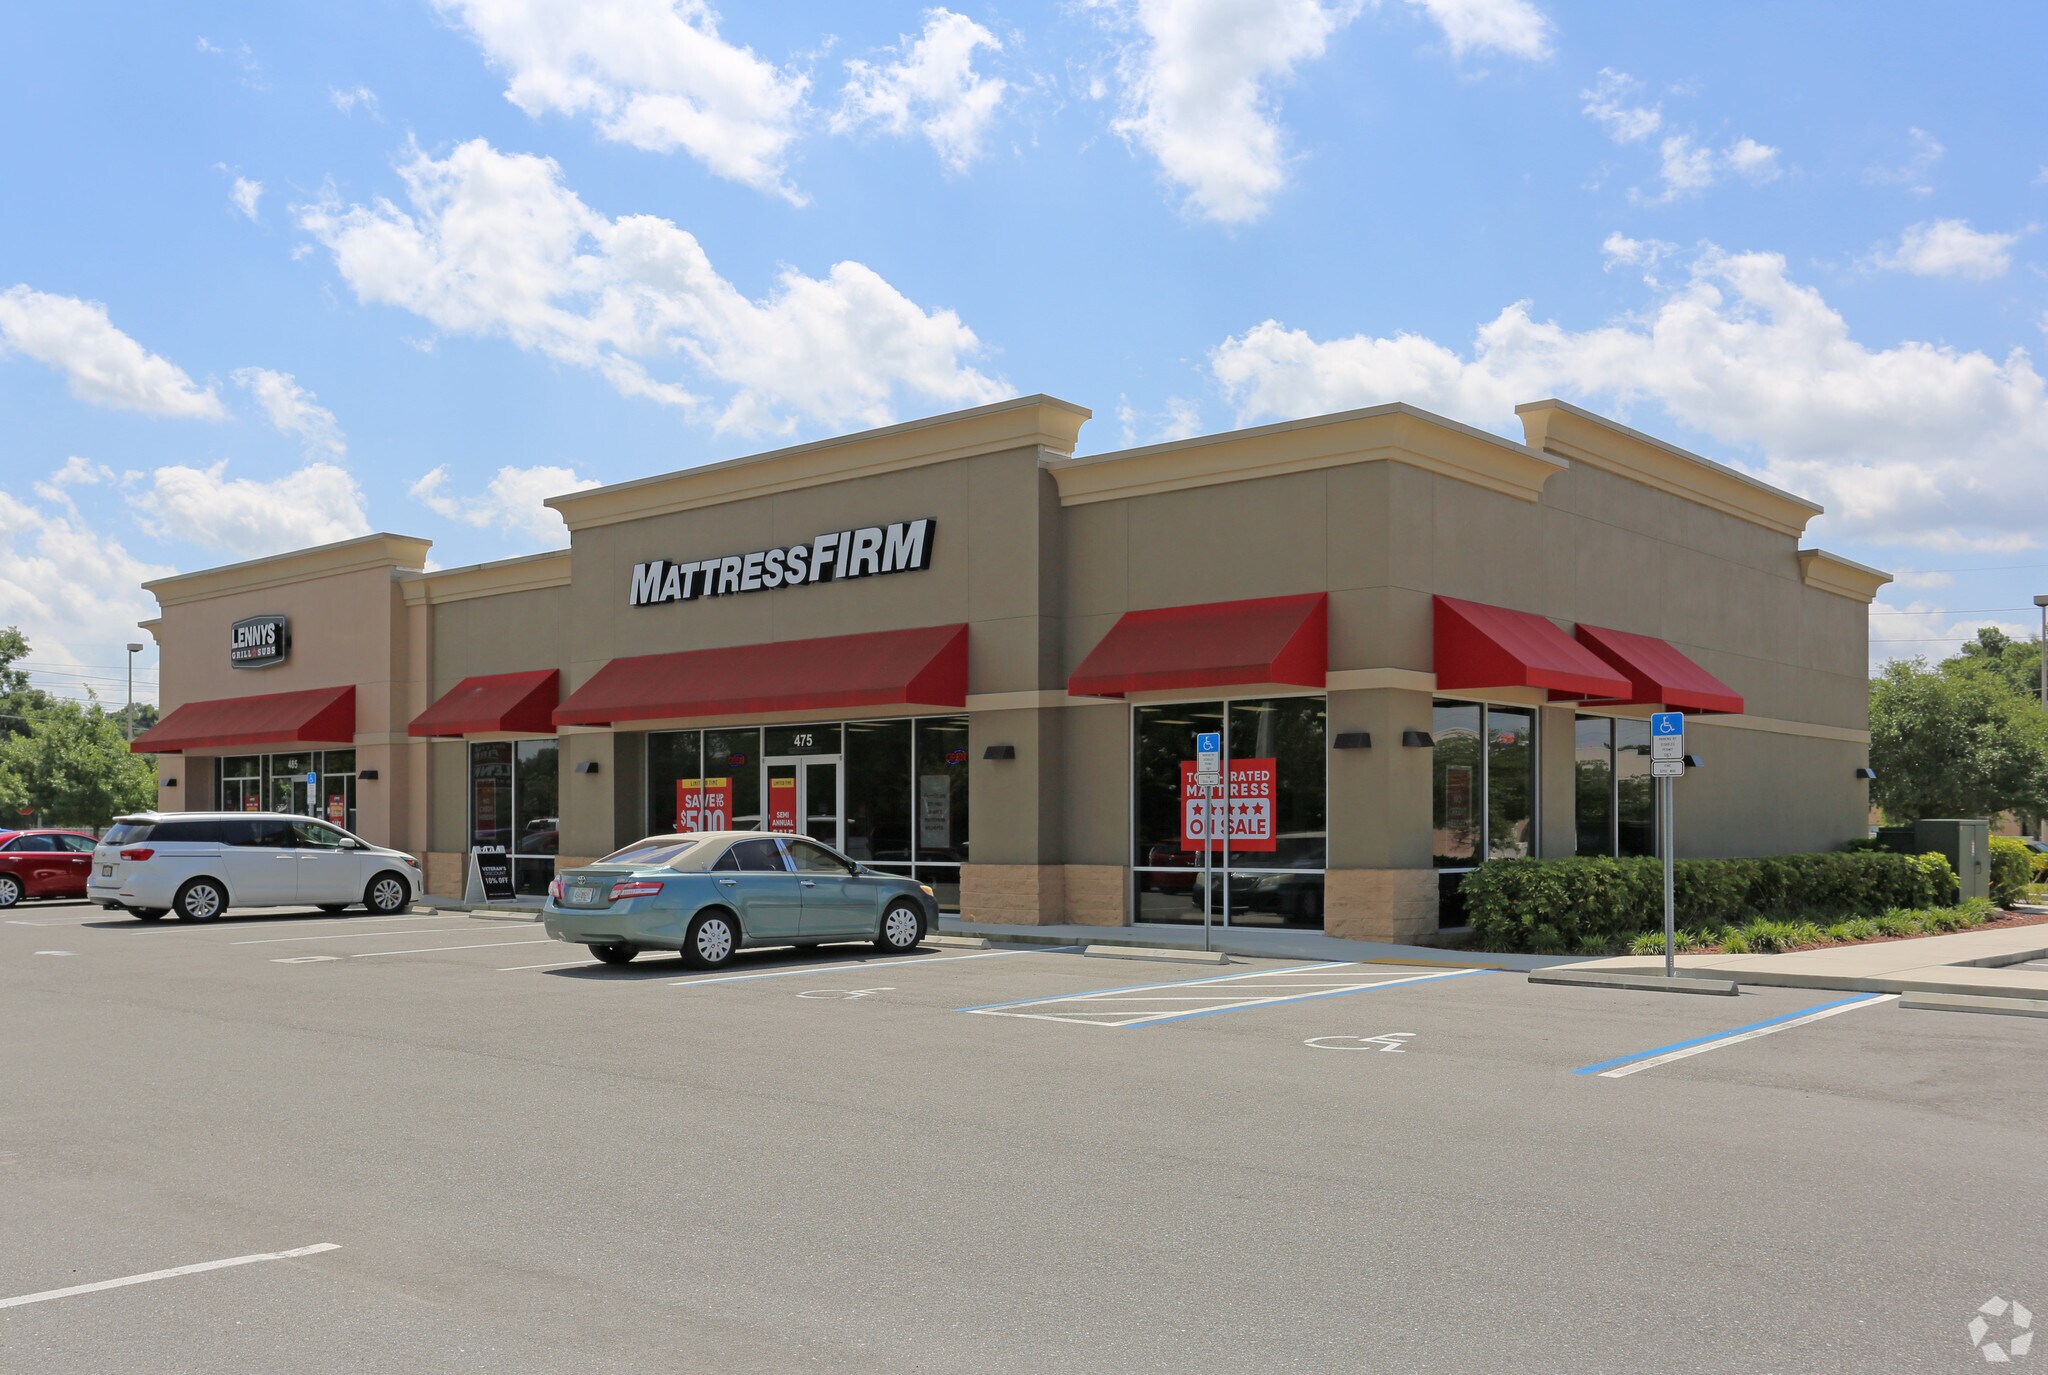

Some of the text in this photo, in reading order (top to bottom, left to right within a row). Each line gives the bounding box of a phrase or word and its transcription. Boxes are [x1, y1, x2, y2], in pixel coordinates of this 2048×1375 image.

[231, 622, 276, 649] LENNYS
[231, 646, 276, 660] GRILL SUBS
[794, 734, 813, 747] 475
[287, 759, 298, 769] 485
[685, 793, 724, 808] SAVE UP
[776, 811, 790, 819] SEMI
[772, 819, 794, 827] ANNUAL
[1220, 818, 1267, 835] SALE
[485, 876, 509, 885] 10% OFF
